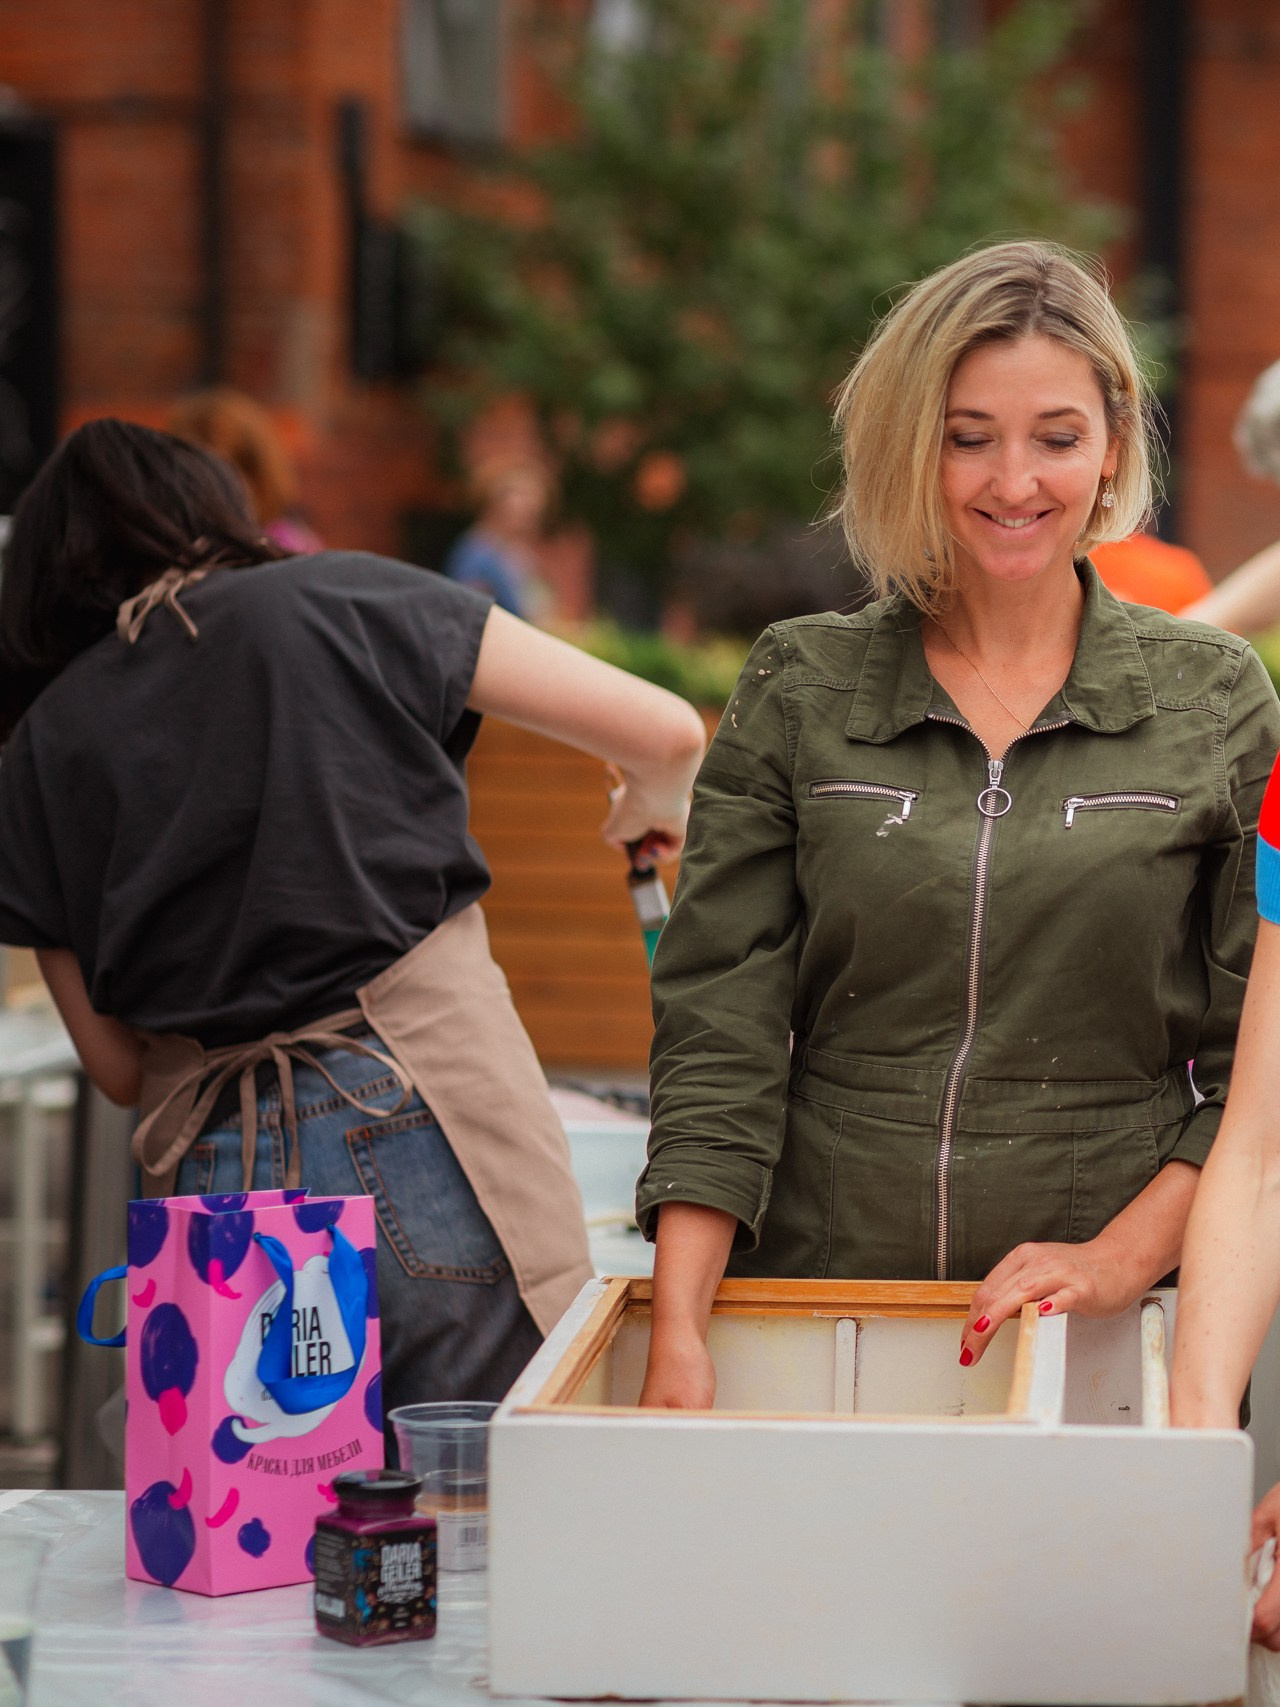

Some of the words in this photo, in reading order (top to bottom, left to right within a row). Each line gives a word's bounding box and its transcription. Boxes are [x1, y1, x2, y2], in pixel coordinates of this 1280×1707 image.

[260, 1306, 322, 1345] DRIA
[247, 1452, 288, 1476] КРАСКА
[290, 1457, 315, 1477] ДЛЯ
[317, 1438, 364, 1471] МЕБЕЛИ
[380, 1542, 422, 1565] DARIA
[380, 1563, 423, 1583] GEILER
